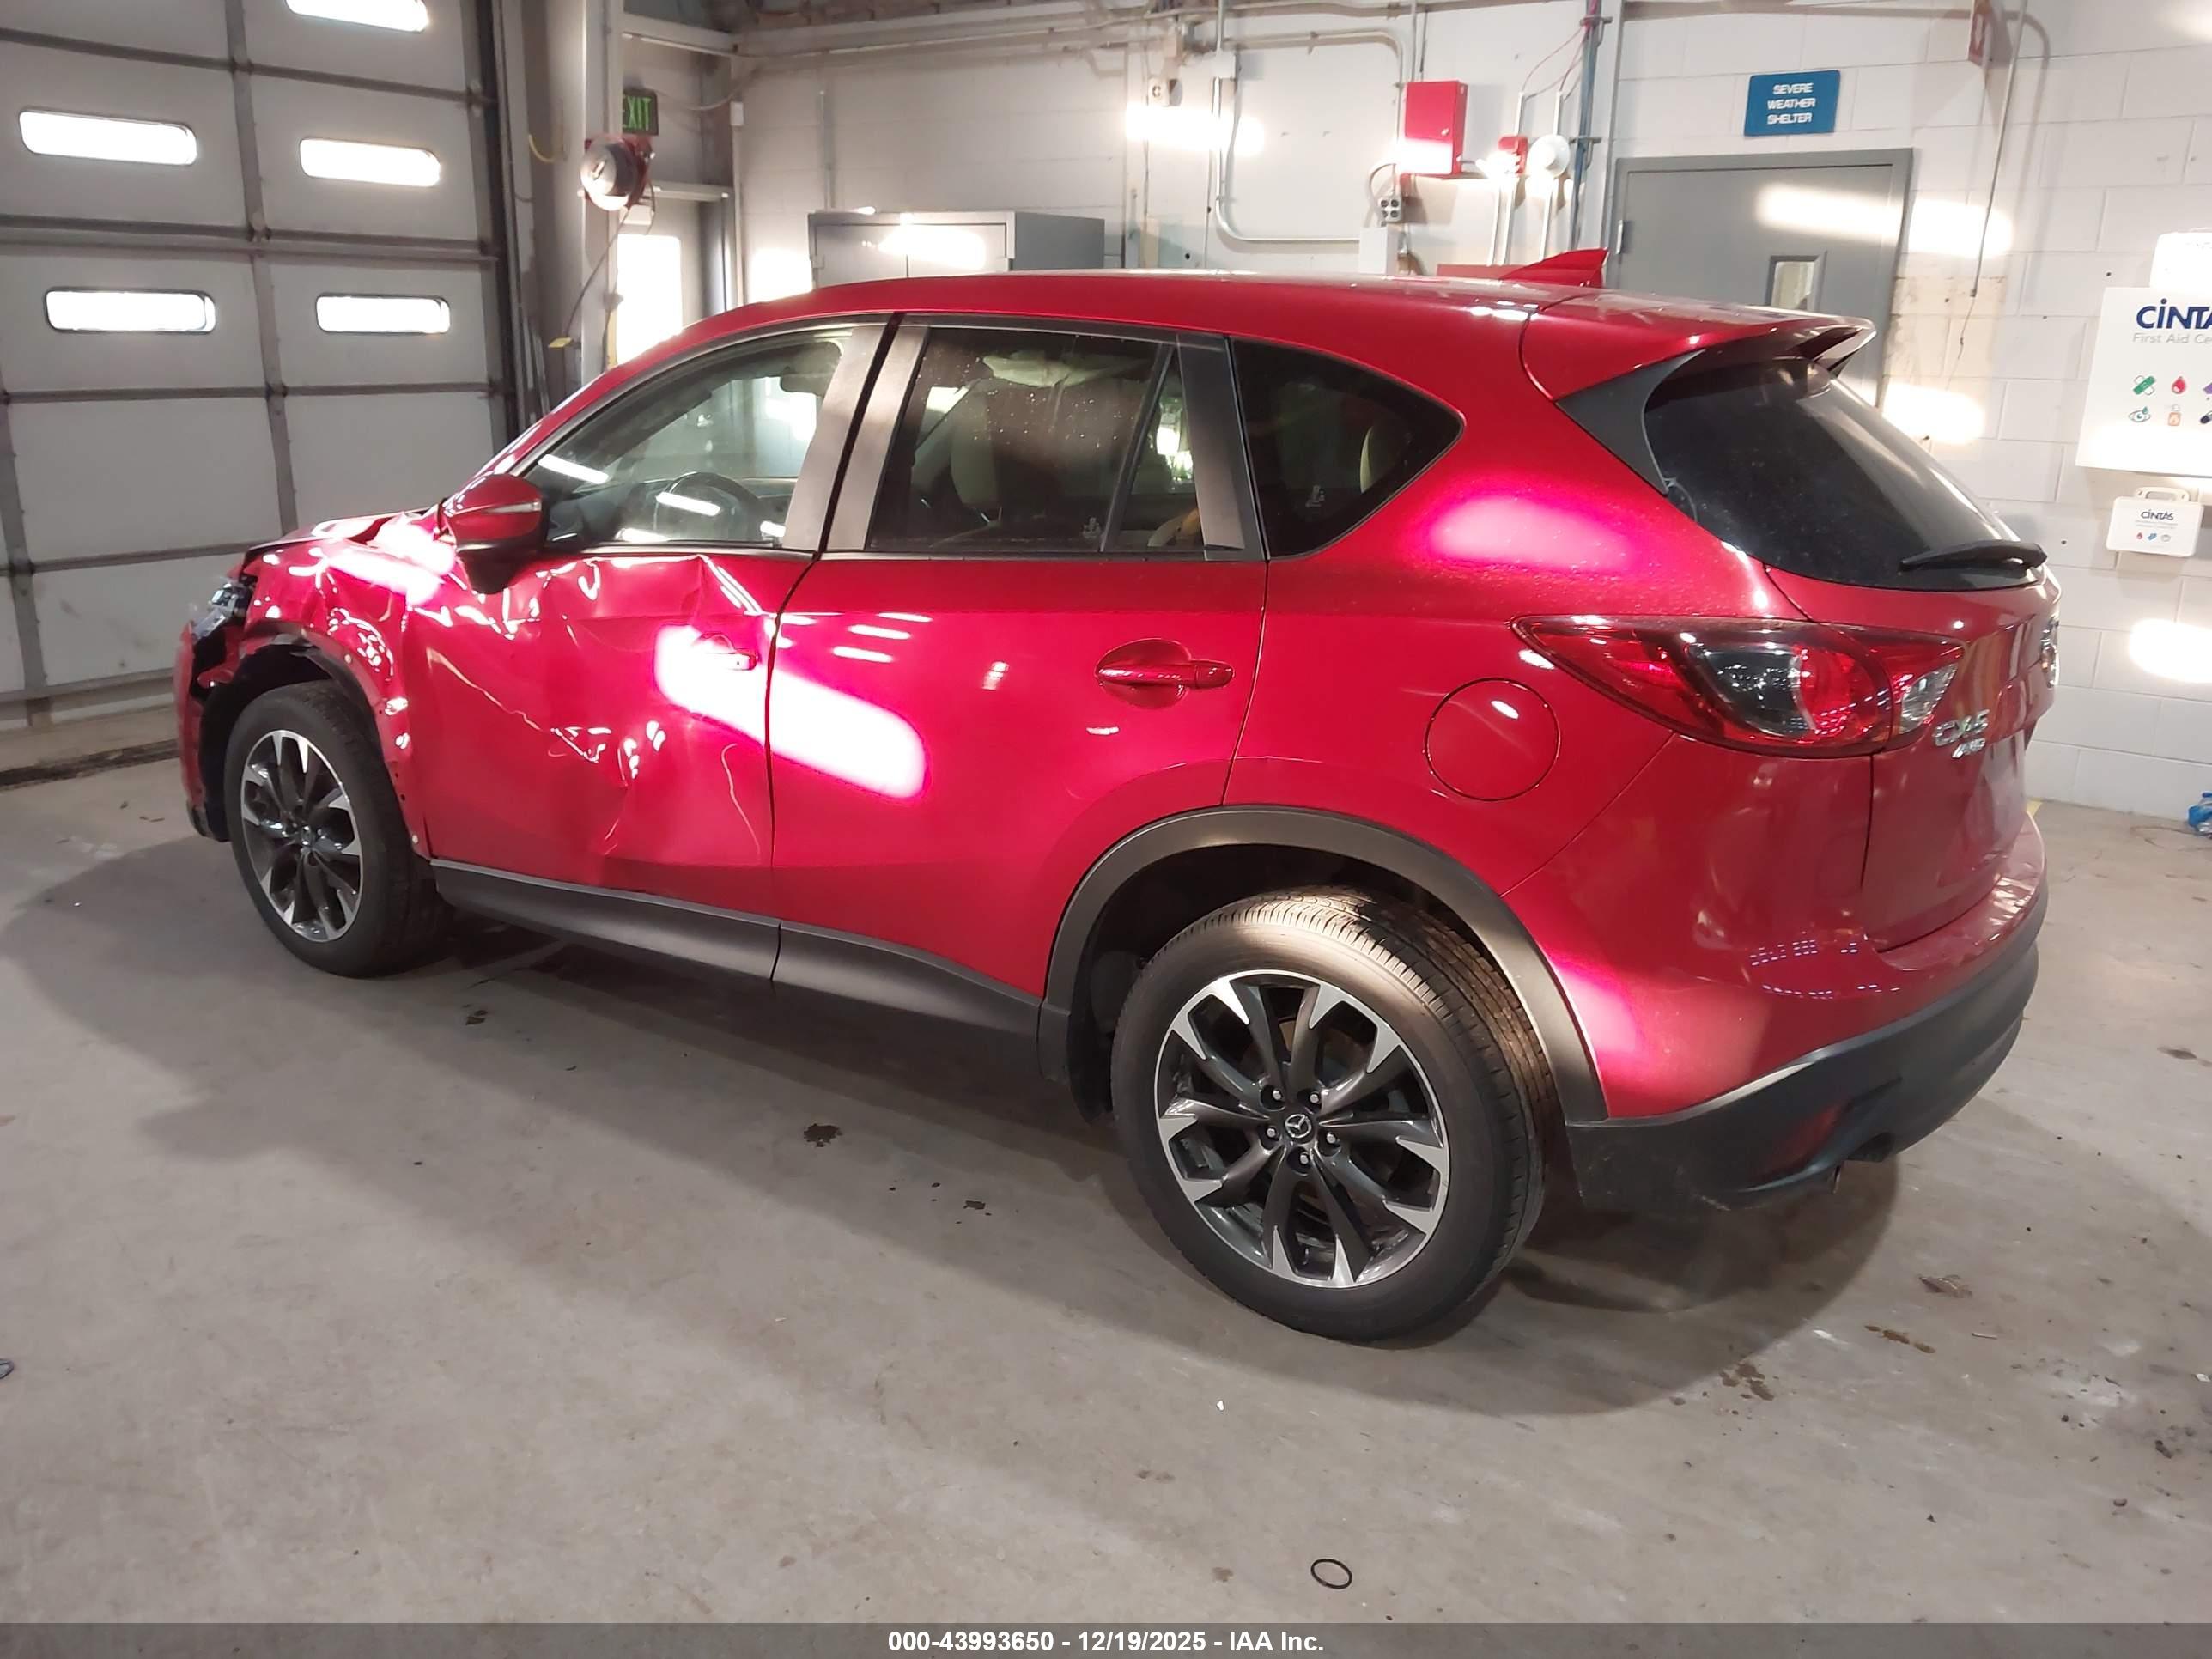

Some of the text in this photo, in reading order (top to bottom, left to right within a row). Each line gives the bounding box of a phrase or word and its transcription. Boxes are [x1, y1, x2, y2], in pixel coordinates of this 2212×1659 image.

[1772, 82, 1814, 94] SEVERE
[1767, 98, 1816, 109] WEATHER
[1767, 112, 1813, 125] SHELTER
[2132, 332, 2161, 343] First
[2166, 333, 2190, 343] Aid
